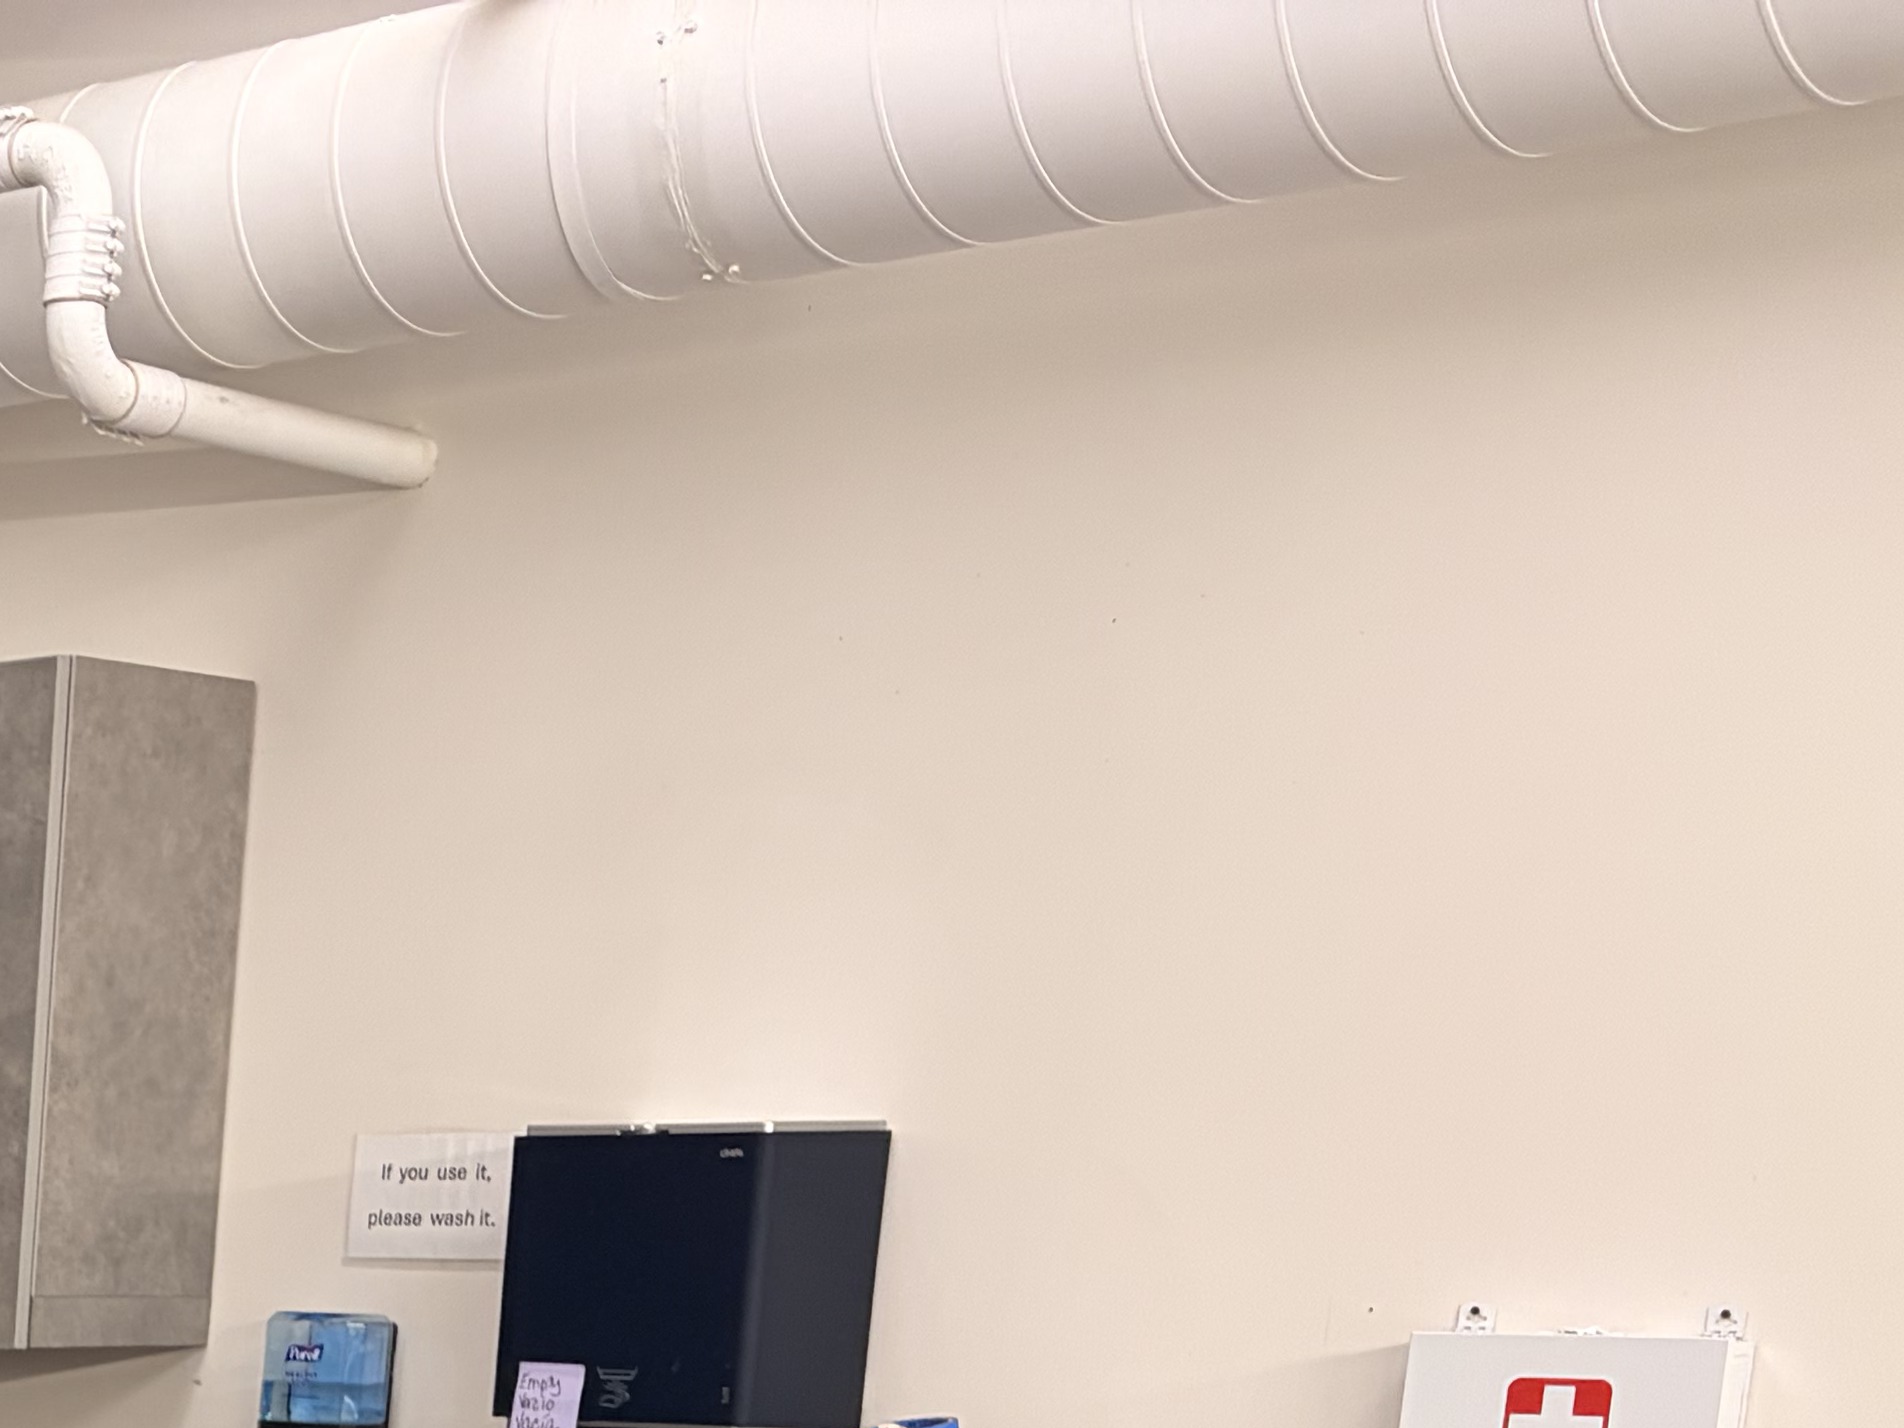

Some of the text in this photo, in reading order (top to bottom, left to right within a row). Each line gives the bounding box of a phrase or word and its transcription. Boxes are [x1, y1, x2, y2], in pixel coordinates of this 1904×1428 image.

[381, 1163, 393, 1180] If
[399, 1166, 429, 1184] you
[437, 1166, 467, 1181] use
[367, 1209, 496, 1229] please wash it.
